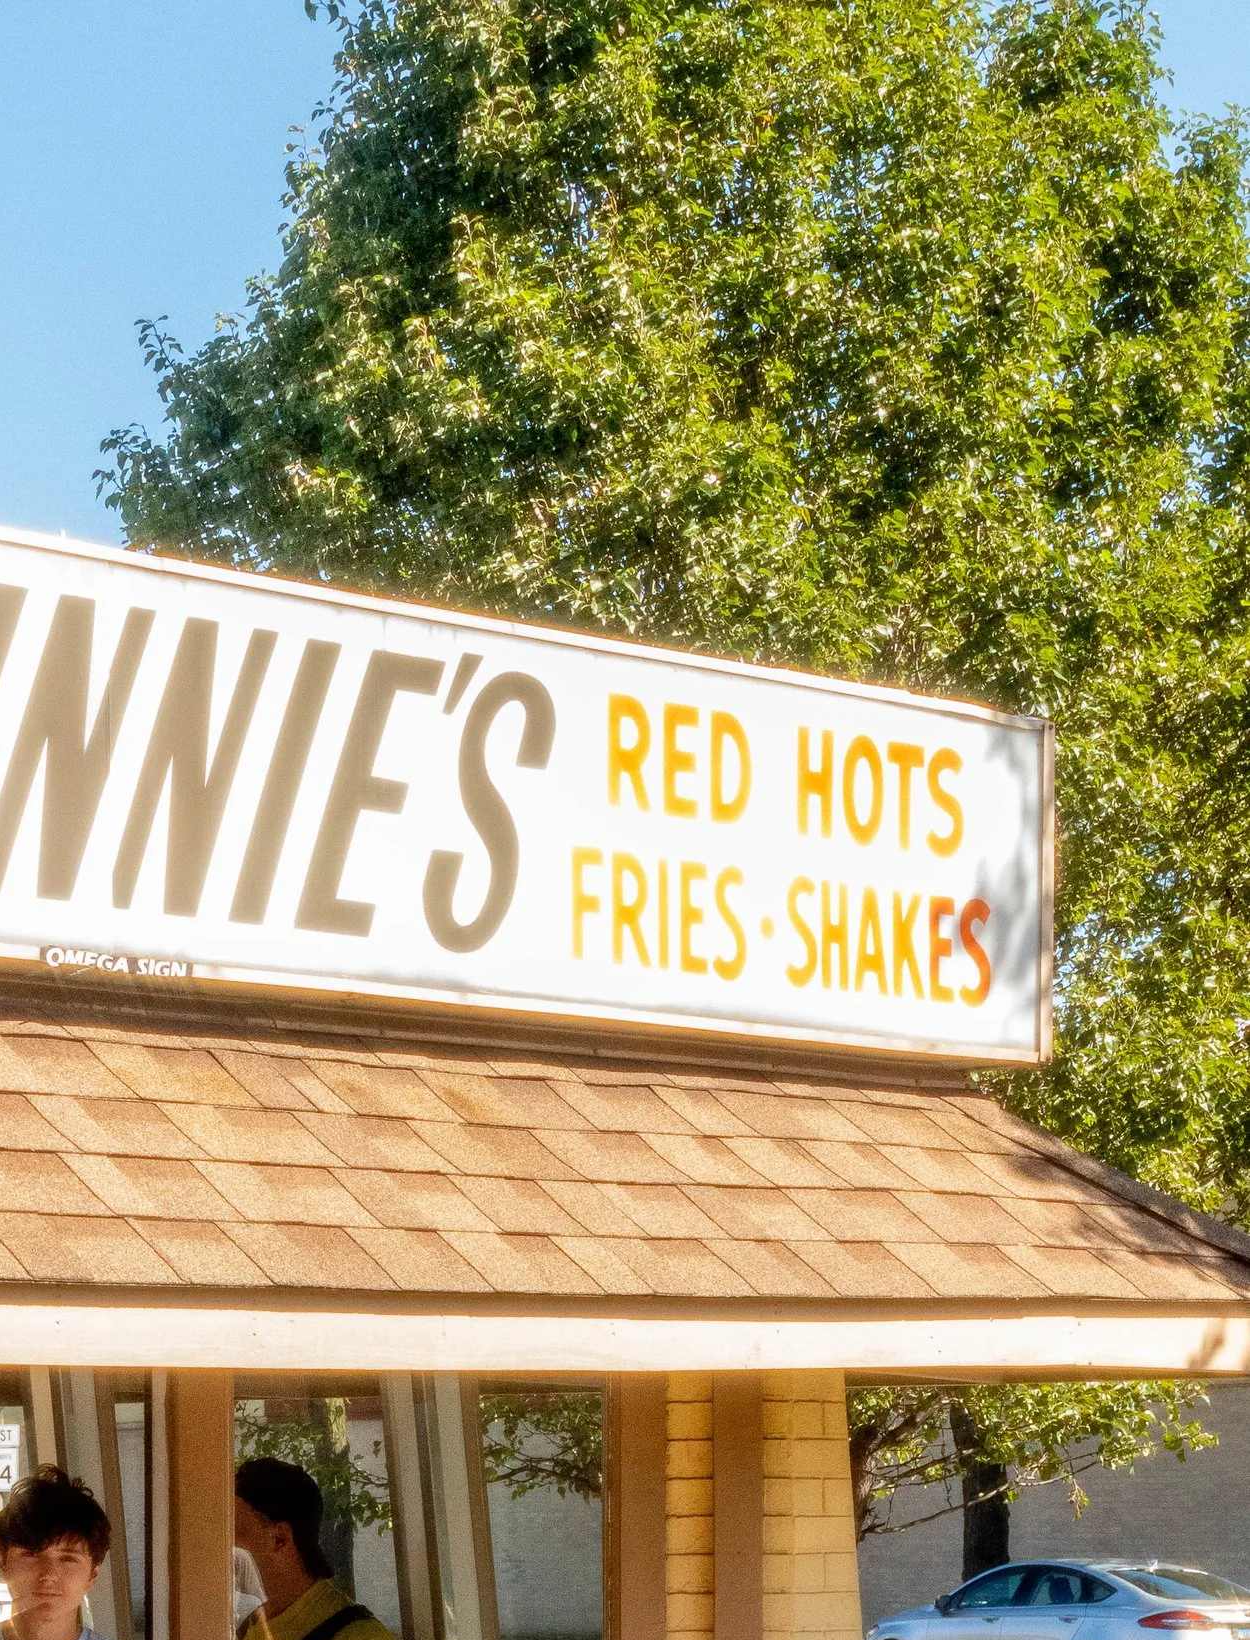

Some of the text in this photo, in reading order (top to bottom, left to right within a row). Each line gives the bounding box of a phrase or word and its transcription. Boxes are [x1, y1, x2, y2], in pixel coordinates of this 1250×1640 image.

[607, 692, 965, 859] RED HOTS
[46, 948, 187, 977] OMEGA SIGN
[571, 845, 748, 981] FRIES
[785, 875, 992, 1007] SHAKES
